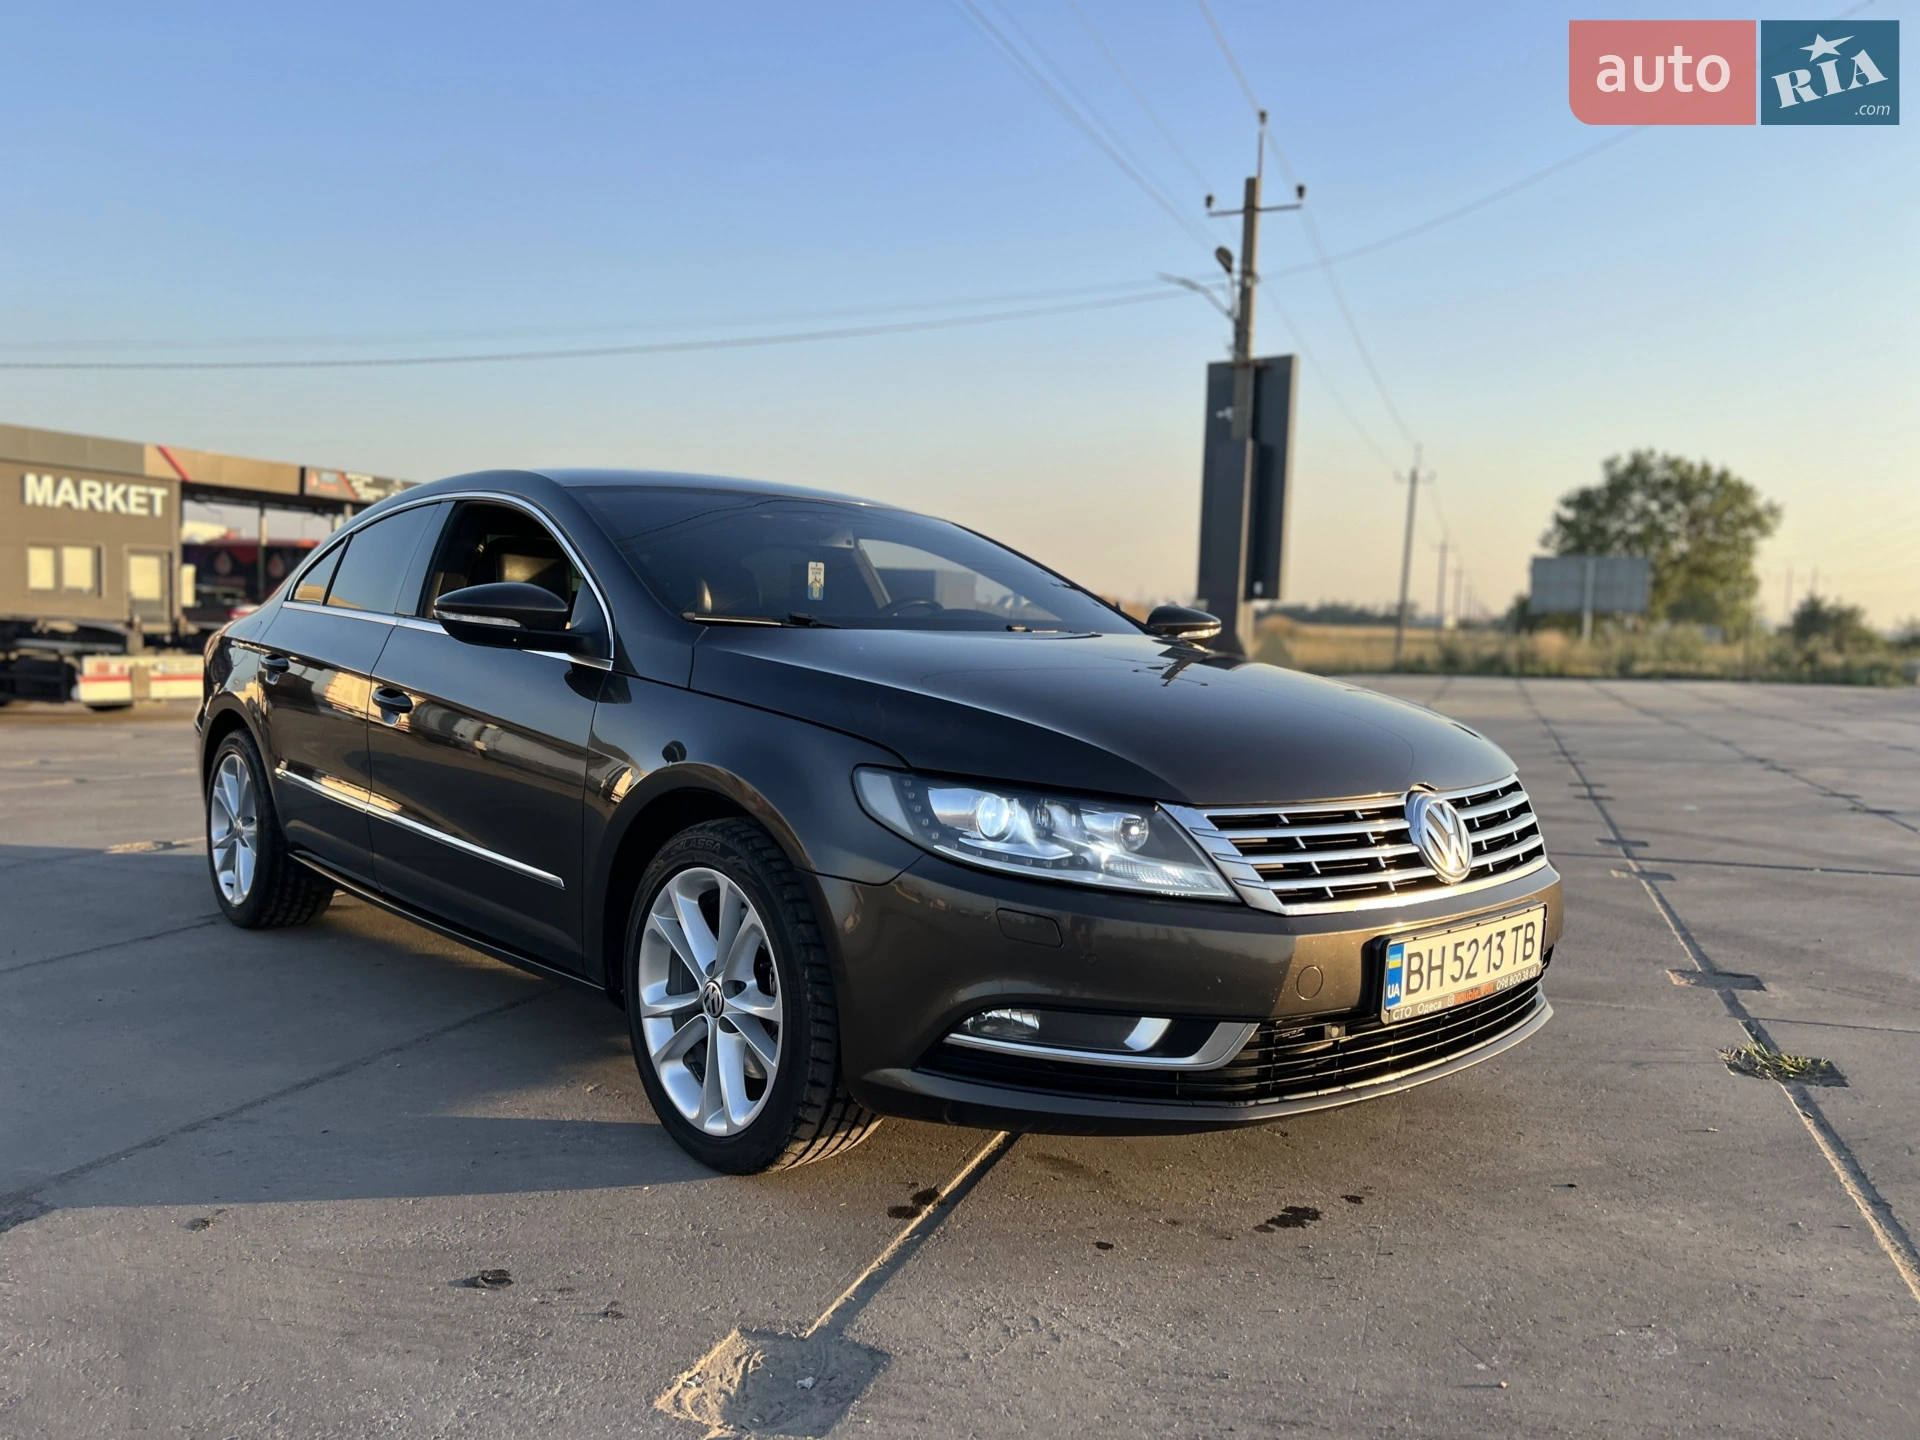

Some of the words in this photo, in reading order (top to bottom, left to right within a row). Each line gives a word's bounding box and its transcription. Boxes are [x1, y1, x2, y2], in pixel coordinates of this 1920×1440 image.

[23, 472, 168, 517] MARKET
[1405, 945, 1446, 996] BH
[1450, 930, 1507, 983] 5213
[1511, 921, 1536, 966] TB
[1387, 983, 1400, 999] UA
[1392, 1006, 1412, 1021] СТО
[1417, 1001, 1442, 1015] Одеса
